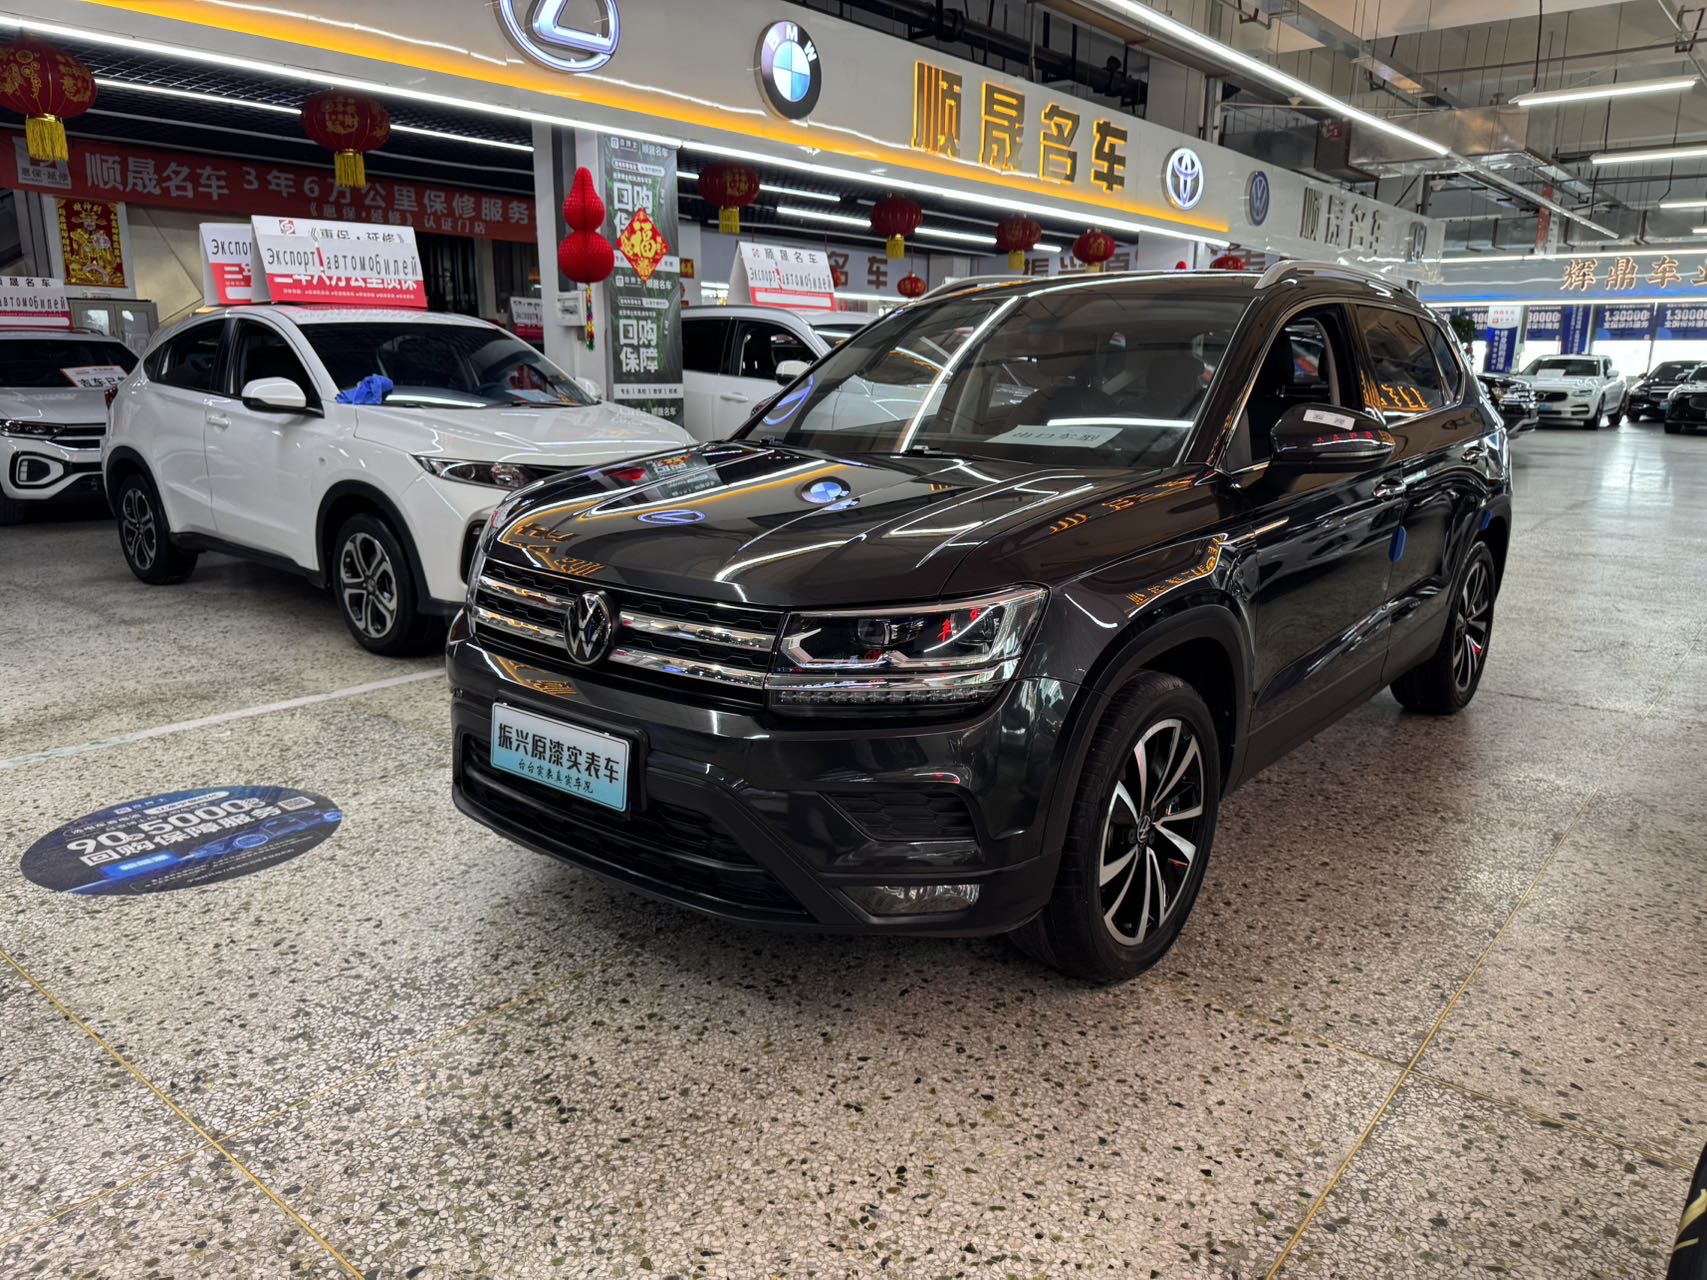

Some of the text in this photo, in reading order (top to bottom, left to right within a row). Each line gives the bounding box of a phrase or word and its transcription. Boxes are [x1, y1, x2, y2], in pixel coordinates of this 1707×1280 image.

[911, 59, 1128, 193] 顺晟名车
[84, 151, 229, 201] 顺晟名车
[613, 181, 653, 216] 回购
[266, 248, 316, 273] Экспорт
[326, 254, 419, 277] автомобилей
[0, 277, 51, 288] 晟名车
[619, 318, 657, 346] 回购
[619, 346, 659, 373] 保障
[498, 723, 620, 784] 振兴原漆实表车
[79, 806, 282, 867] 回购保障服务
